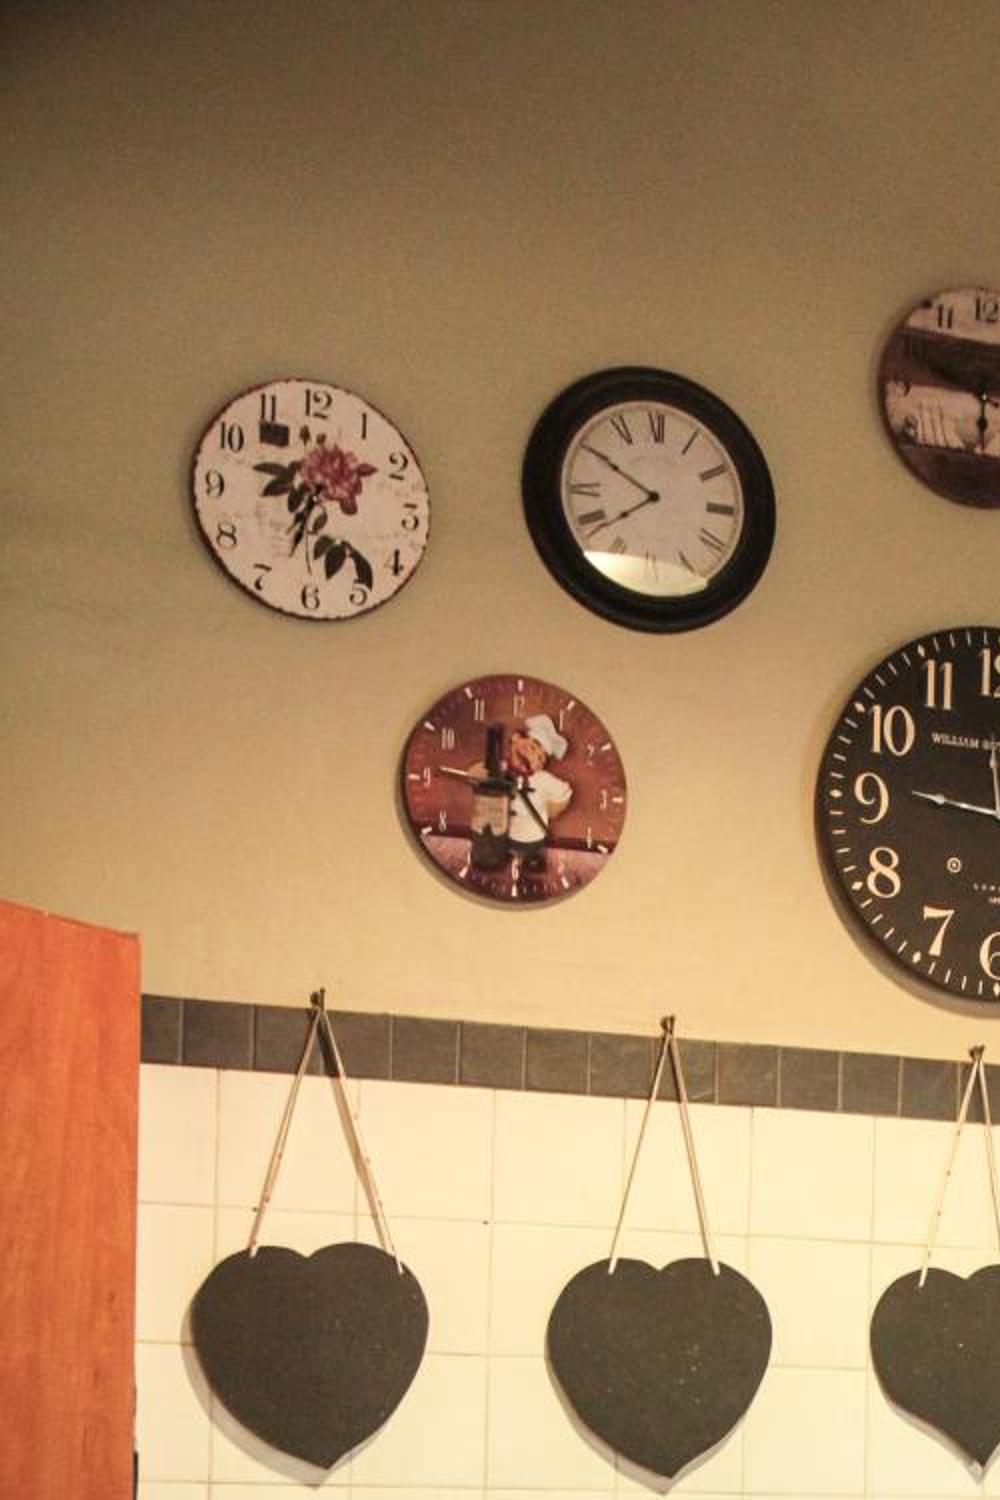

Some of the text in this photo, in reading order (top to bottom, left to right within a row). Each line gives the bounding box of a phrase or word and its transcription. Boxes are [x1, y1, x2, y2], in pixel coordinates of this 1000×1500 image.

[975, 297, 999, 322] 12
[305, 389, 333, 420] 12
[220, 422, 245, 452] 10
[361, 412, 368, 439] 1
[389, 452, 409, 480] 2
[205, 470, 225, 497] 9
[401, 503, 419, 531] 3
[216, 521, 237, 548] 8
[384, 549, 404, 576] 4
[253, 563, 272, 591] 7
[301, 583, 321, 610] 6
[922, 658, 953, 712] 11
[869, 704, 916, 757] 10
[931, 732, 979, 749] WILLIAM
[853, 771, 890, 824] 9
[866, 846, 901, 899] 8
[922, 905, 955, 957] 7
